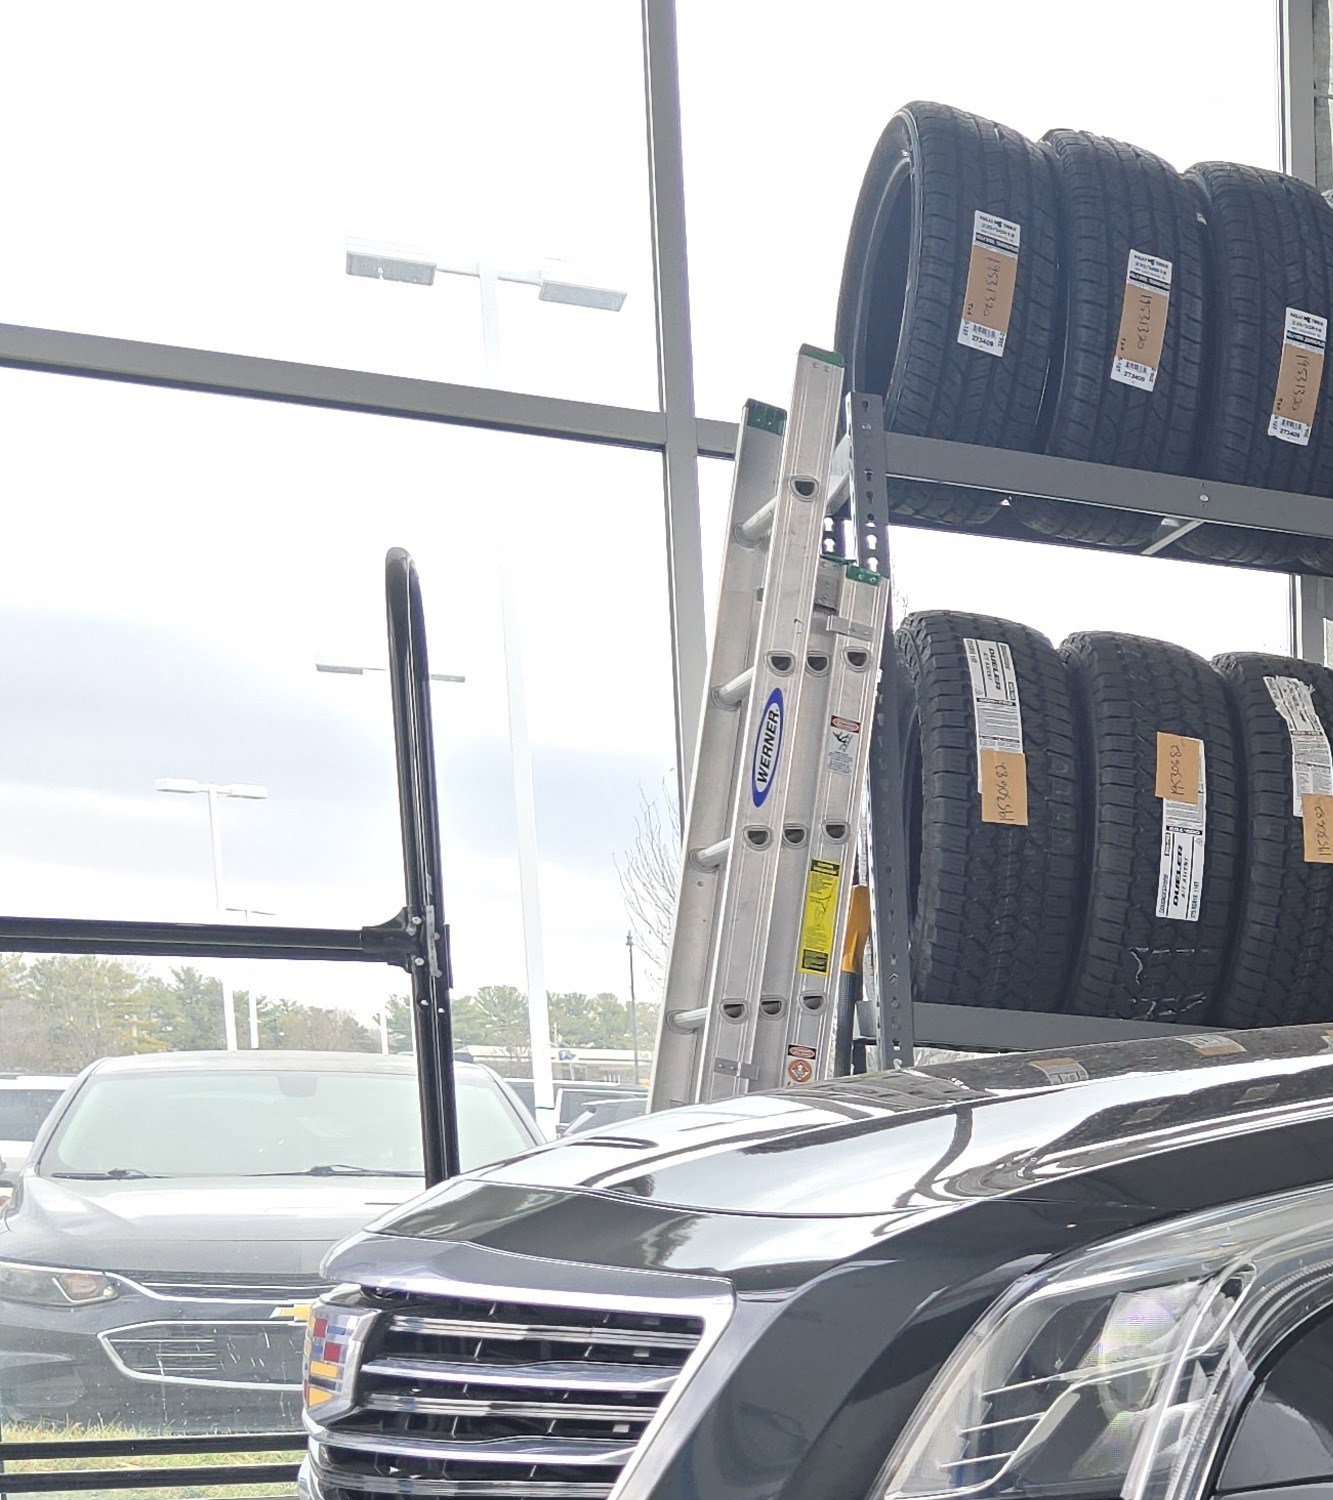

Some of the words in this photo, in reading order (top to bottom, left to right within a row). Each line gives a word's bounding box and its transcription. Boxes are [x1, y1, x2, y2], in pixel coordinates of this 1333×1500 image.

[988, 648, 1001, 691] DUELER
[757, 709, 780, 784] WERNER
[1170, 745, 1184, 796] 19530682
[995, 763, 1015, 821] 19530682
[1173, 845, 1183, 907] DUELER
